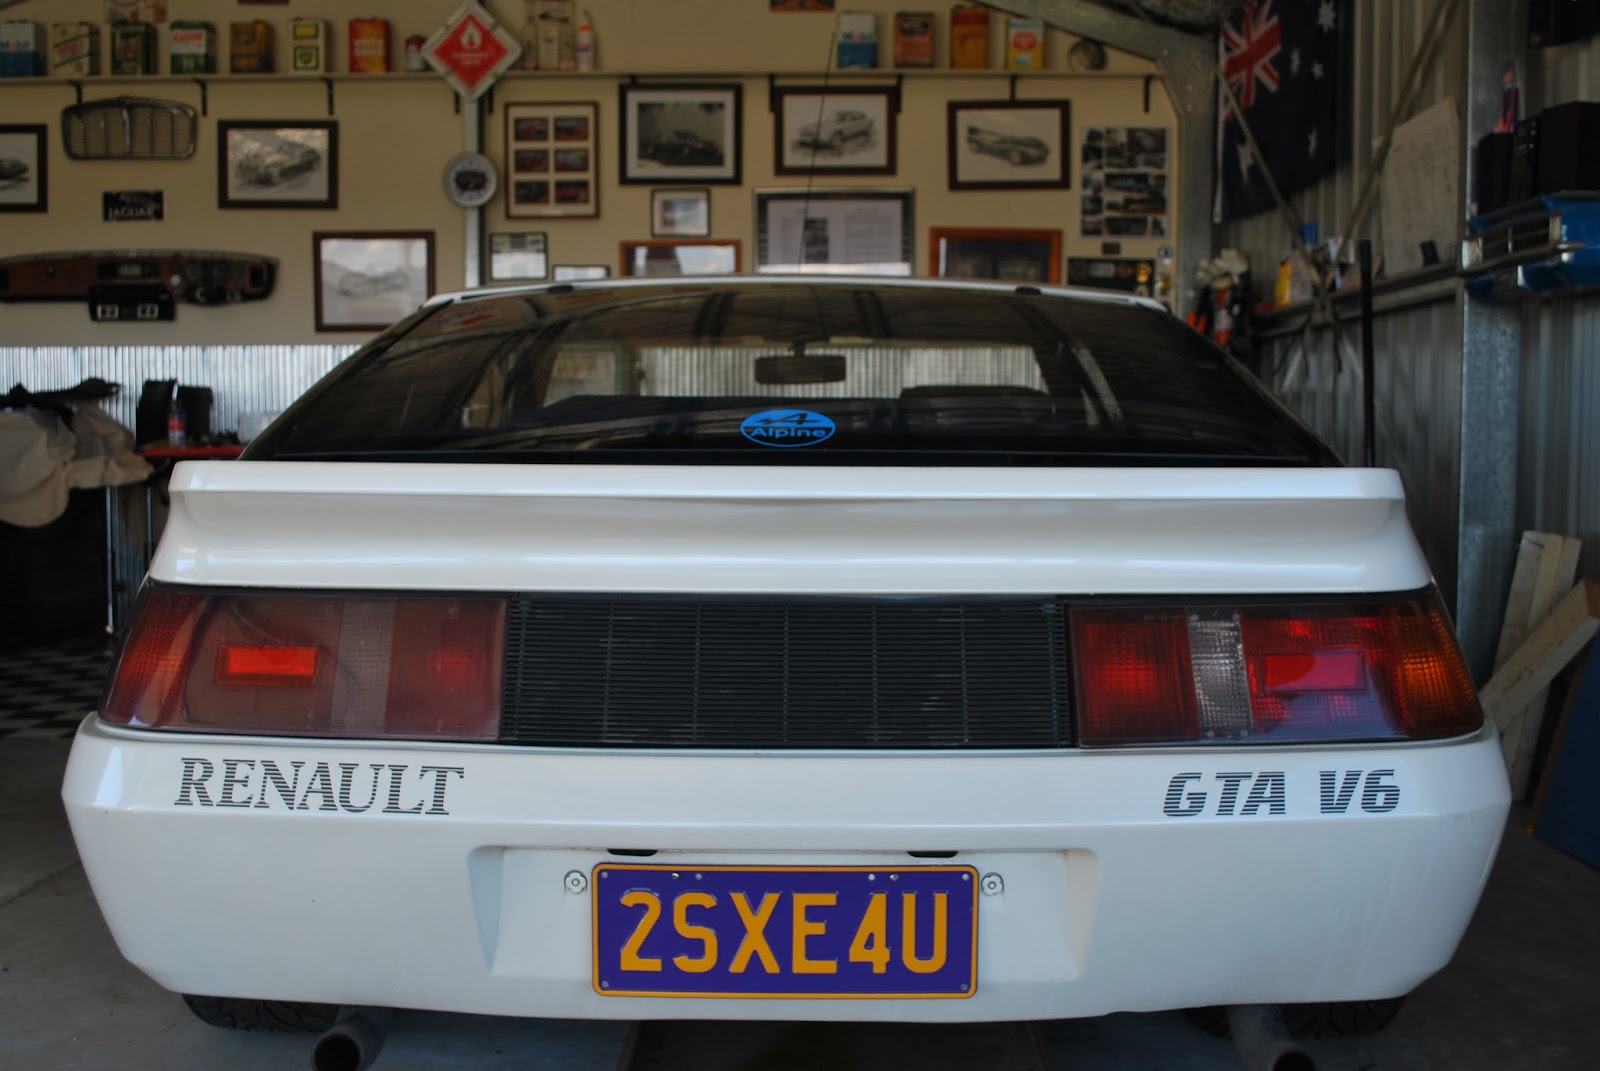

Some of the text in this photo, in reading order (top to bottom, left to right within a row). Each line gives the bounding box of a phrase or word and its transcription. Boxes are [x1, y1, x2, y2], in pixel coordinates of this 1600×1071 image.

[750, 427, 826, 439] Alpine
[174, 757, 465, 815] RENAULT
[1163, 769, 1401, 817] GTA V6
[619, 890, 949, 975] 2SXE4U
